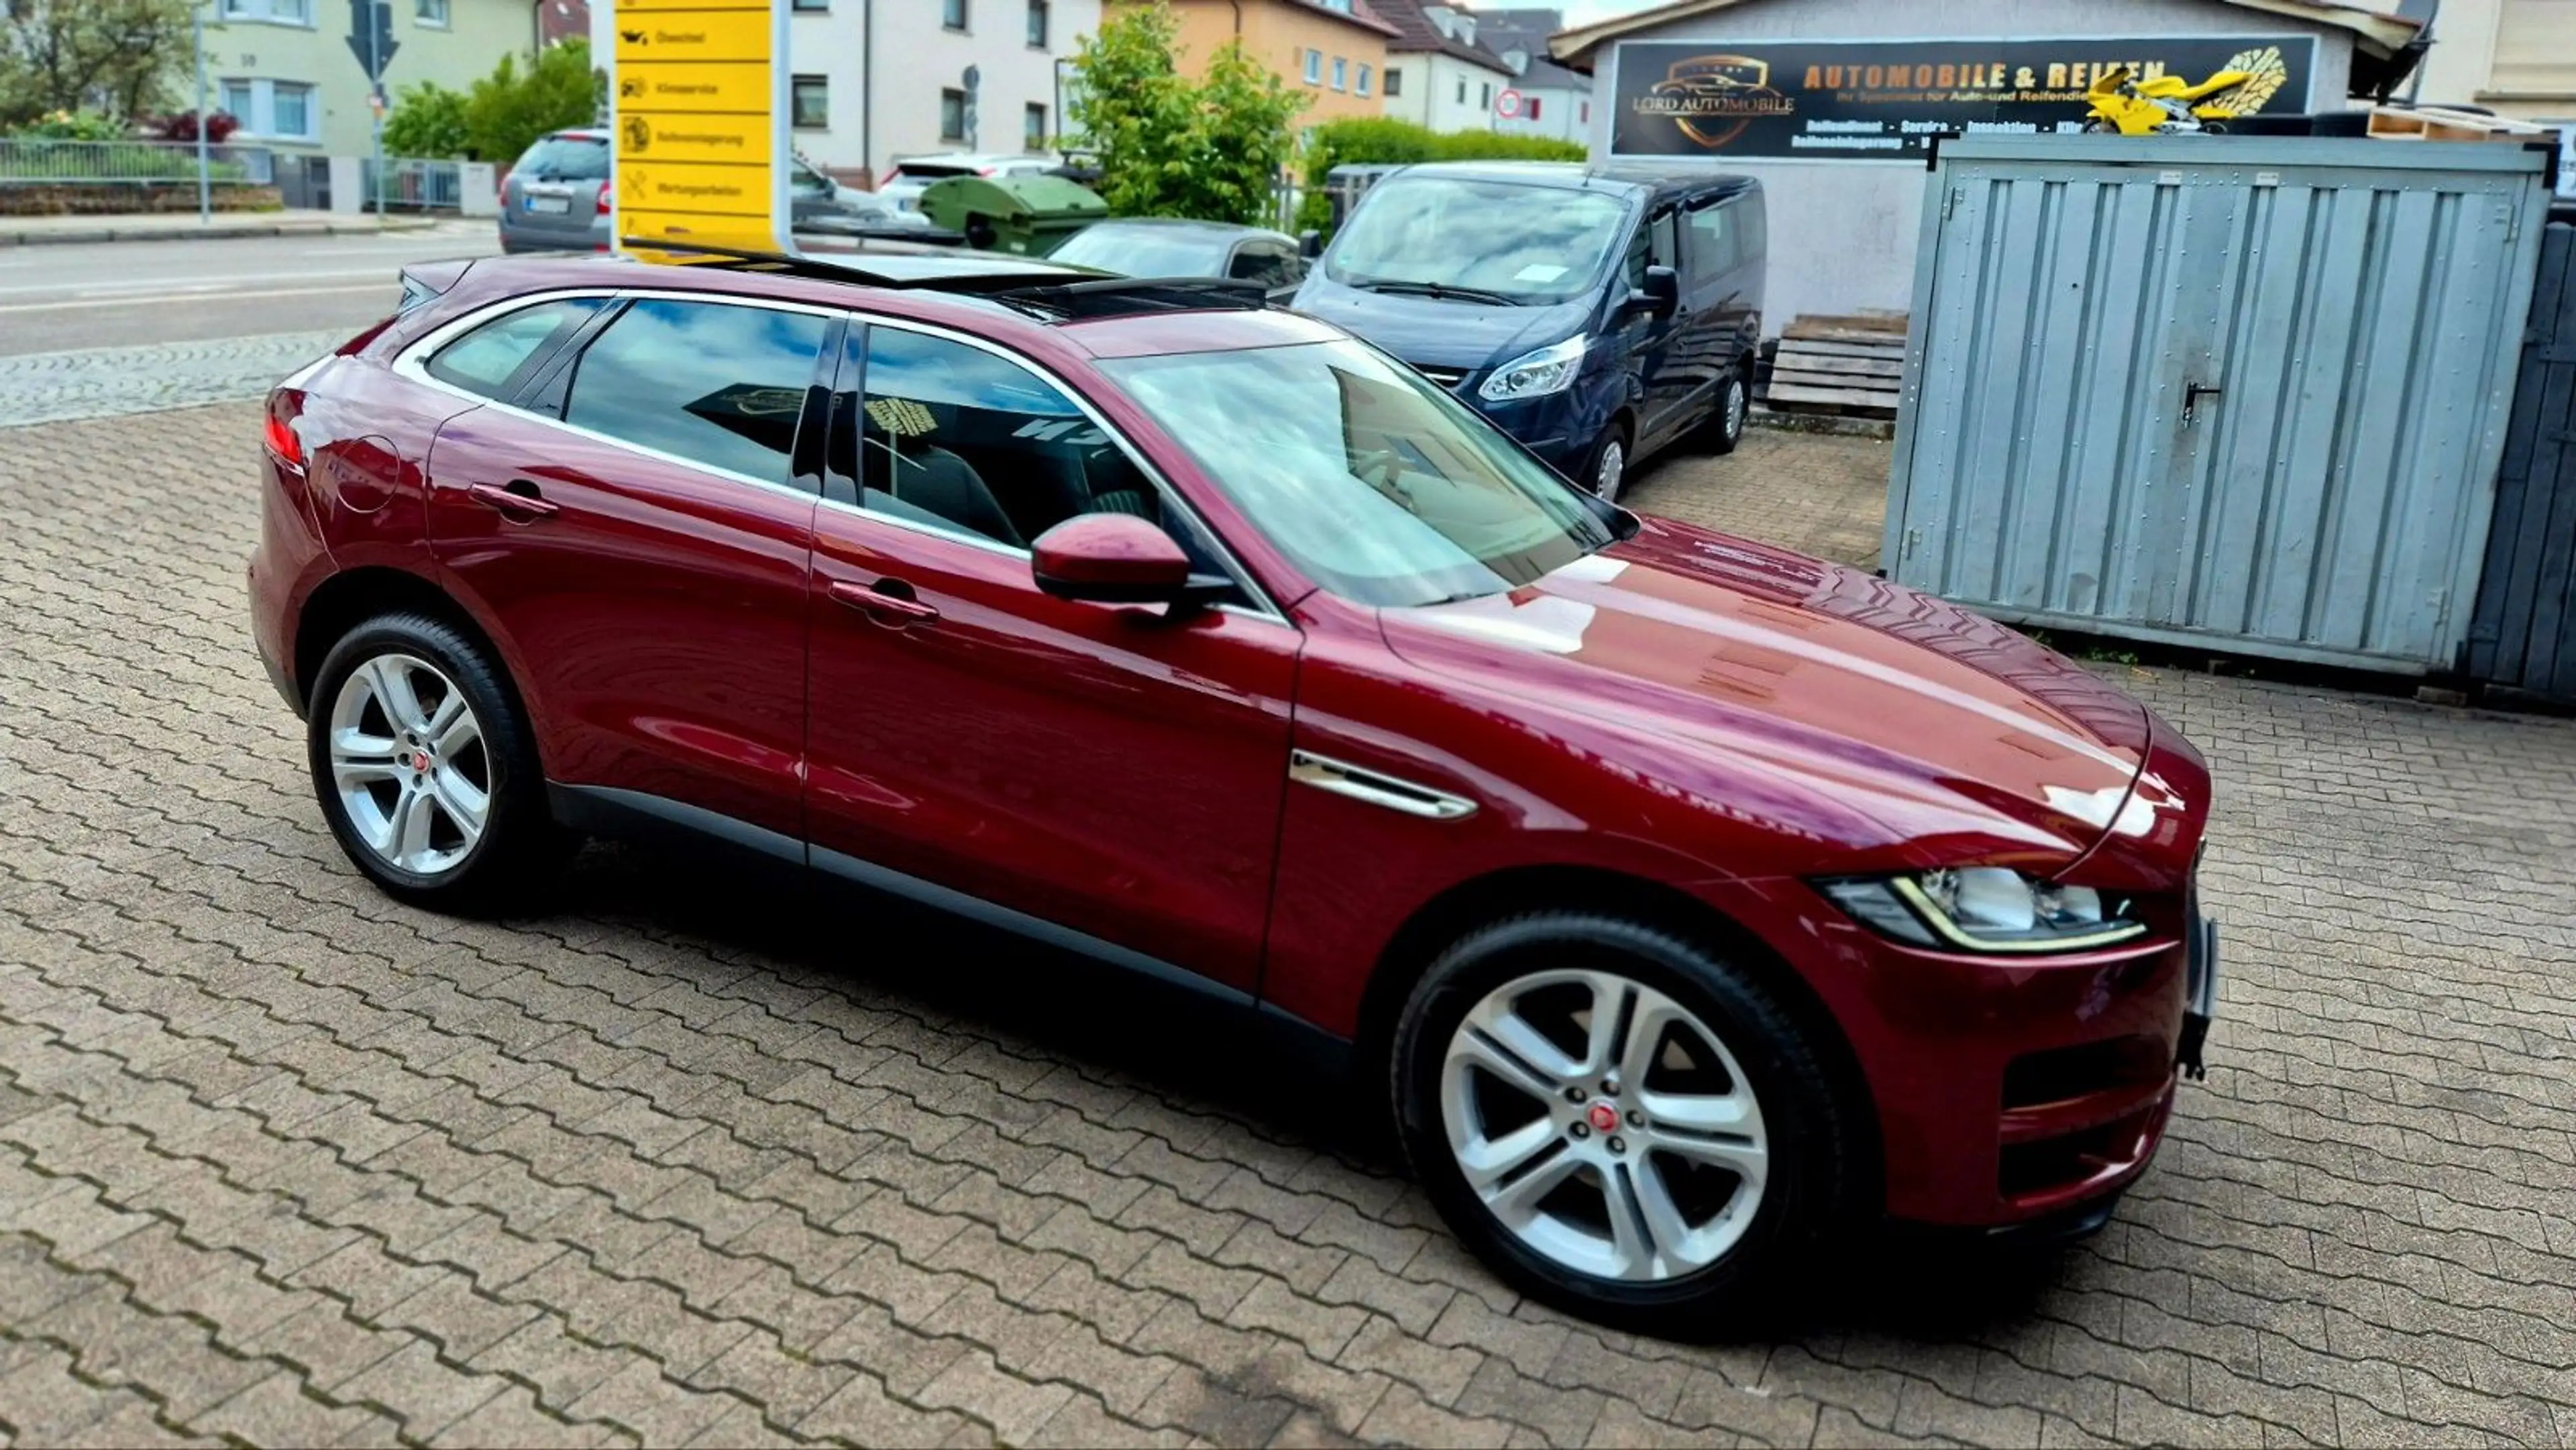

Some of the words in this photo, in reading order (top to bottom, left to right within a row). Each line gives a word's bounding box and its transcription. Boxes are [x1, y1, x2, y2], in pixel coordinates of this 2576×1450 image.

[1804, 63, 2006, 89] AUTOMOBILE
[2015, 66, 2036, 88] &
[1632, 97, 1676, 111] LORD
[1681, 97, 1795, 112] AUTOMOBILE
